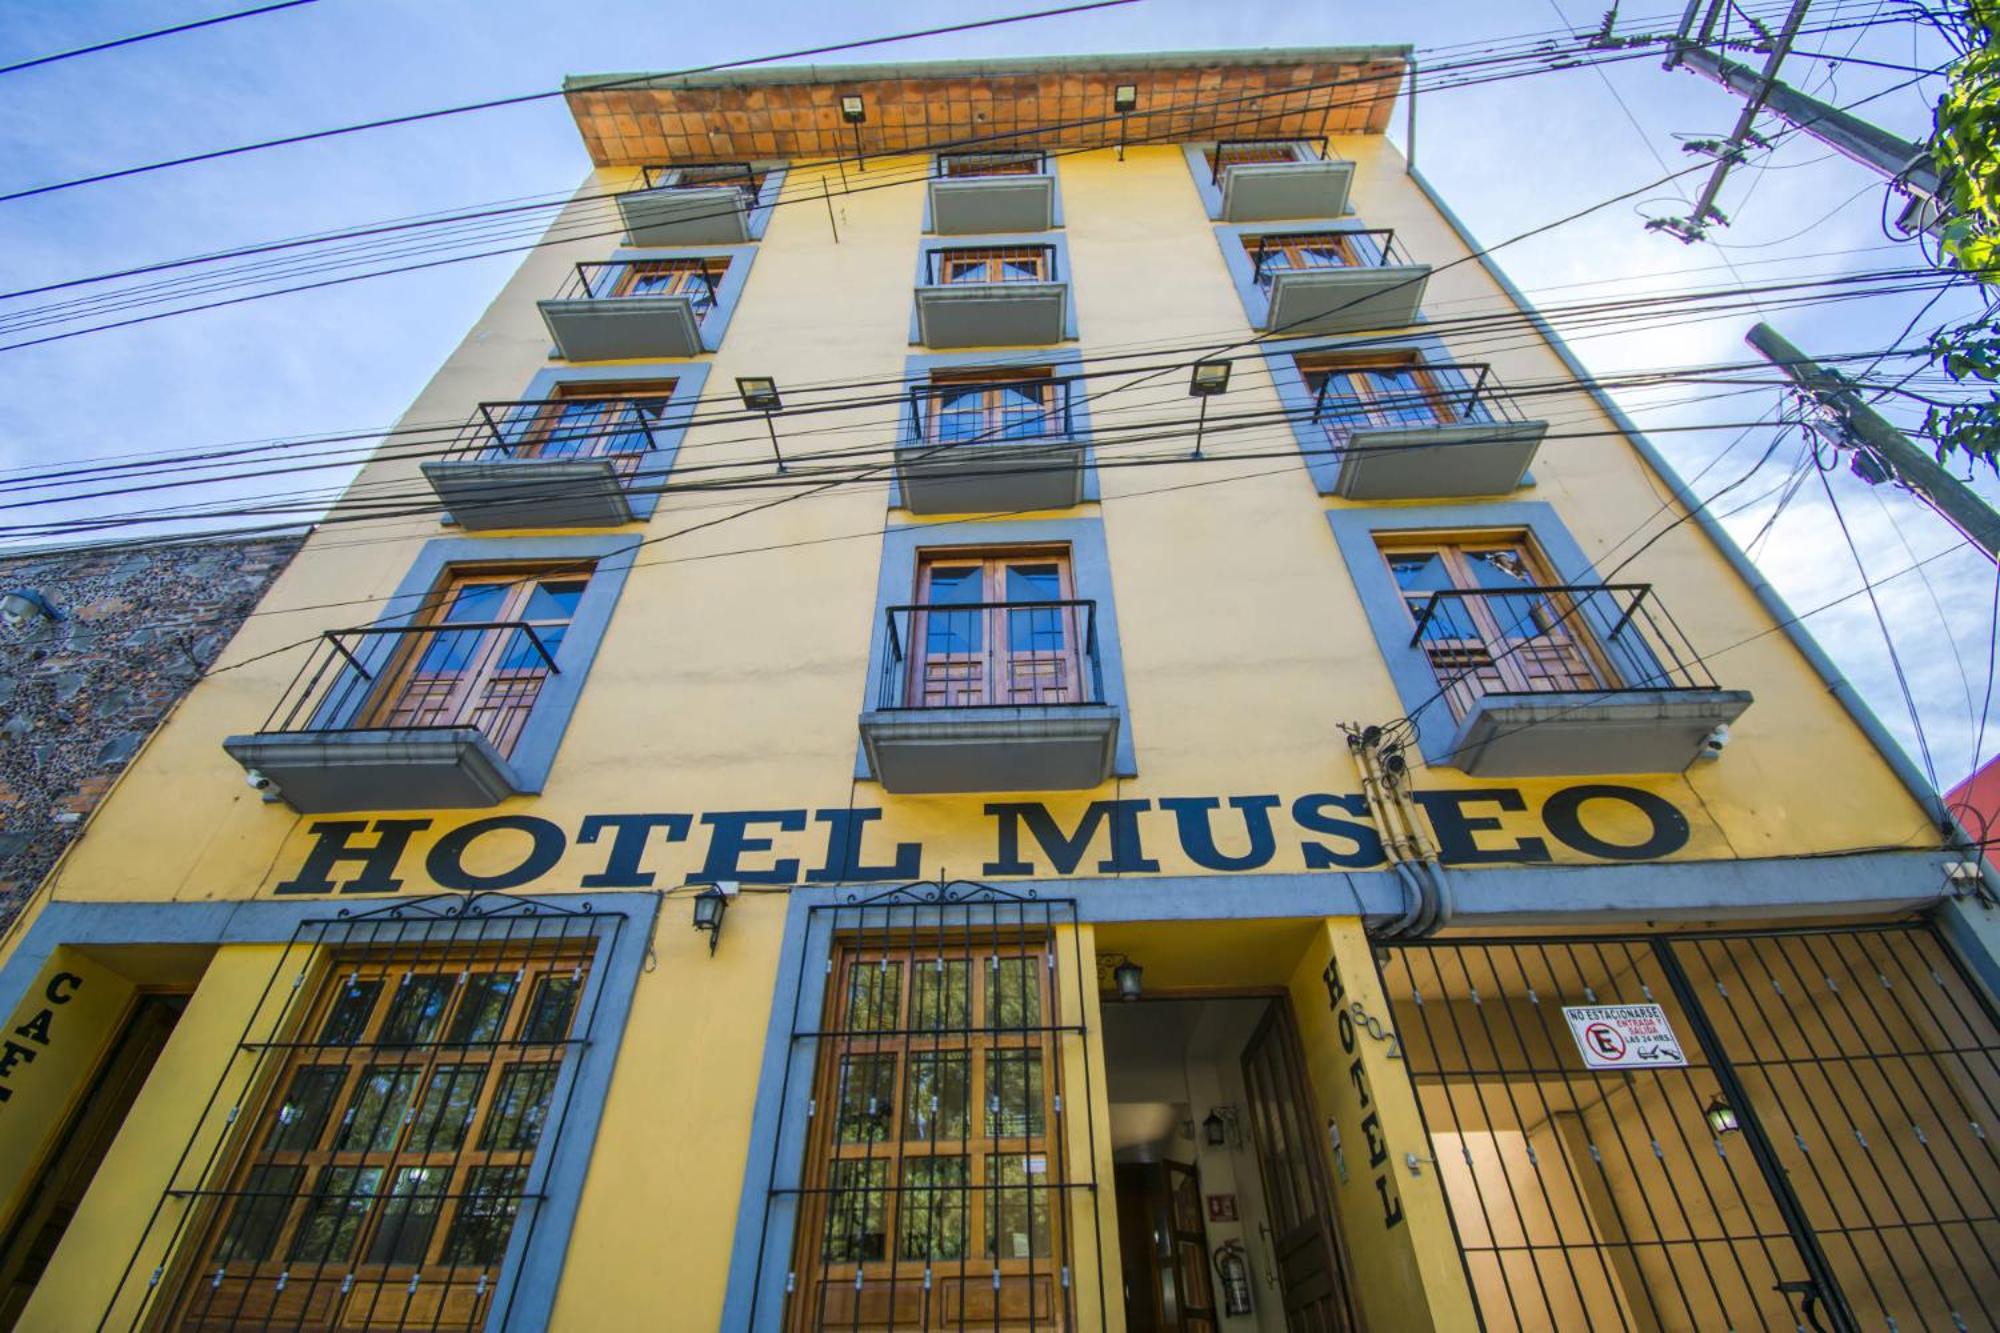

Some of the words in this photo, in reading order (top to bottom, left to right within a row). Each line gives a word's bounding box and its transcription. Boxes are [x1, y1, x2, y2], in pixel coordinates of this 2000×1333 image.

[273, 807, 922, 894] HOTEL
[983, 785, 1690, 875] MUSEO
[1351, 1002, 1401, 1058] 802
[1571, 1011, 1584, 1020] NO
[1588, 1008, 1659, 1020] ESTACIONARSE
[1617, 1018, 1655, 1027] ENTRADA
[1629, 1026, 1659, 1035] SALIDA
[0, 972, 83, 1103] CAF
[1625, 1034, 1641, 1043] LAS
[1643, 1034, 1652, 1043] 24
[1323, 956, 1402, 1230] HOTEL
